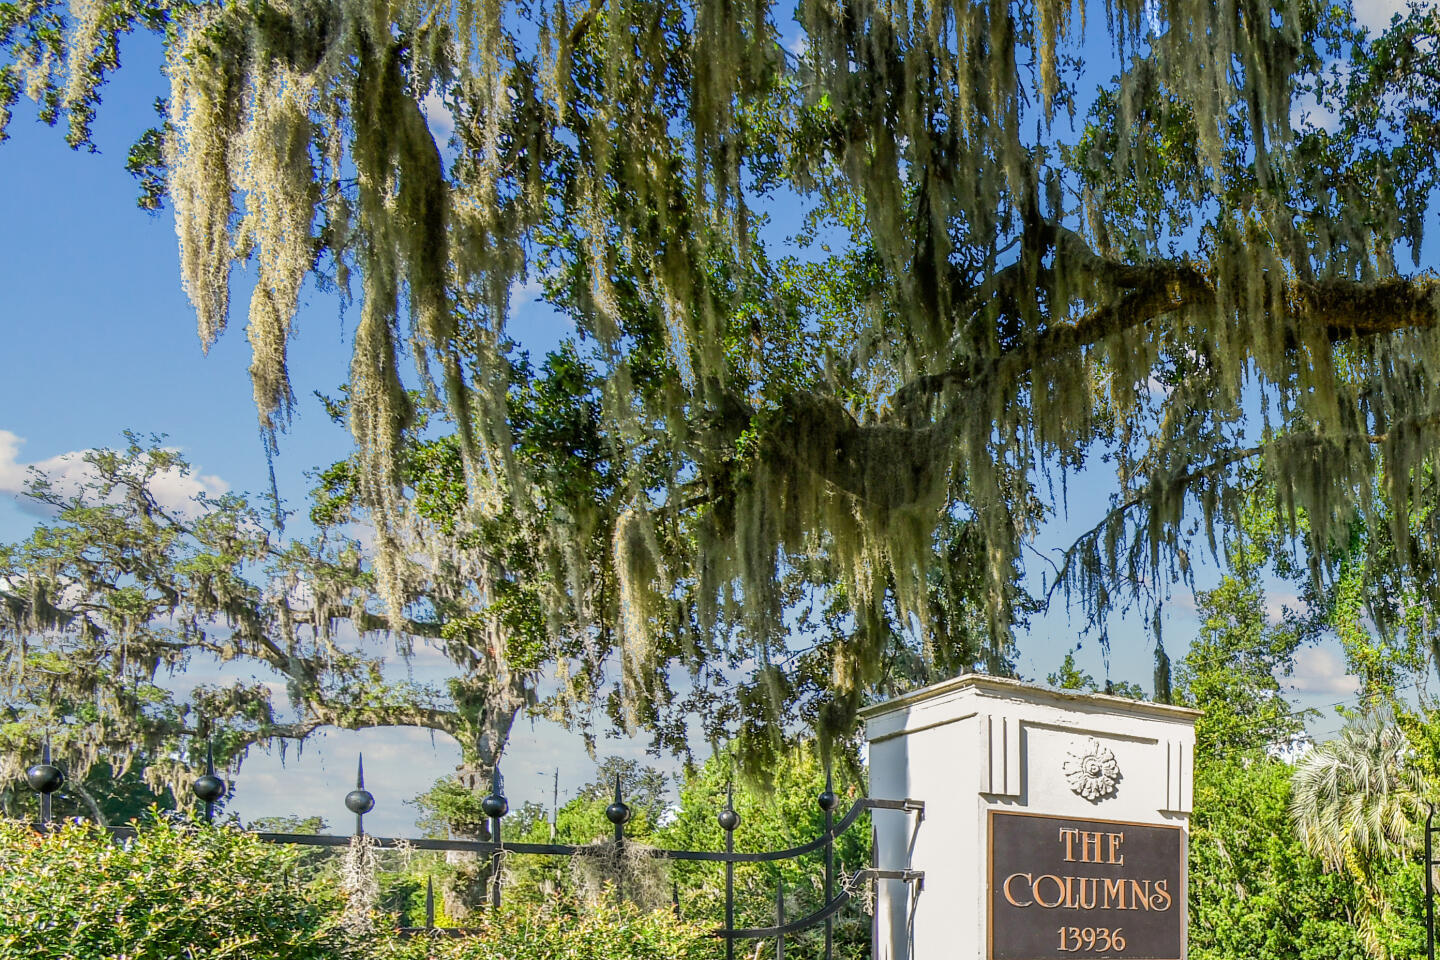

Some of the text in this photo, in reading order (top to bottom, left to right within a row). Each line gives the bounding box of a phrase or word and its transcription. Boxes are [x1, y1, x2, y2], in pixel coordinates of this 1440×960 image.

[1059, 827, 1124, 866] THE
[1003, 873, 1172, 912] COLUMNS
[1057, 926, 1126, 952] 13936
